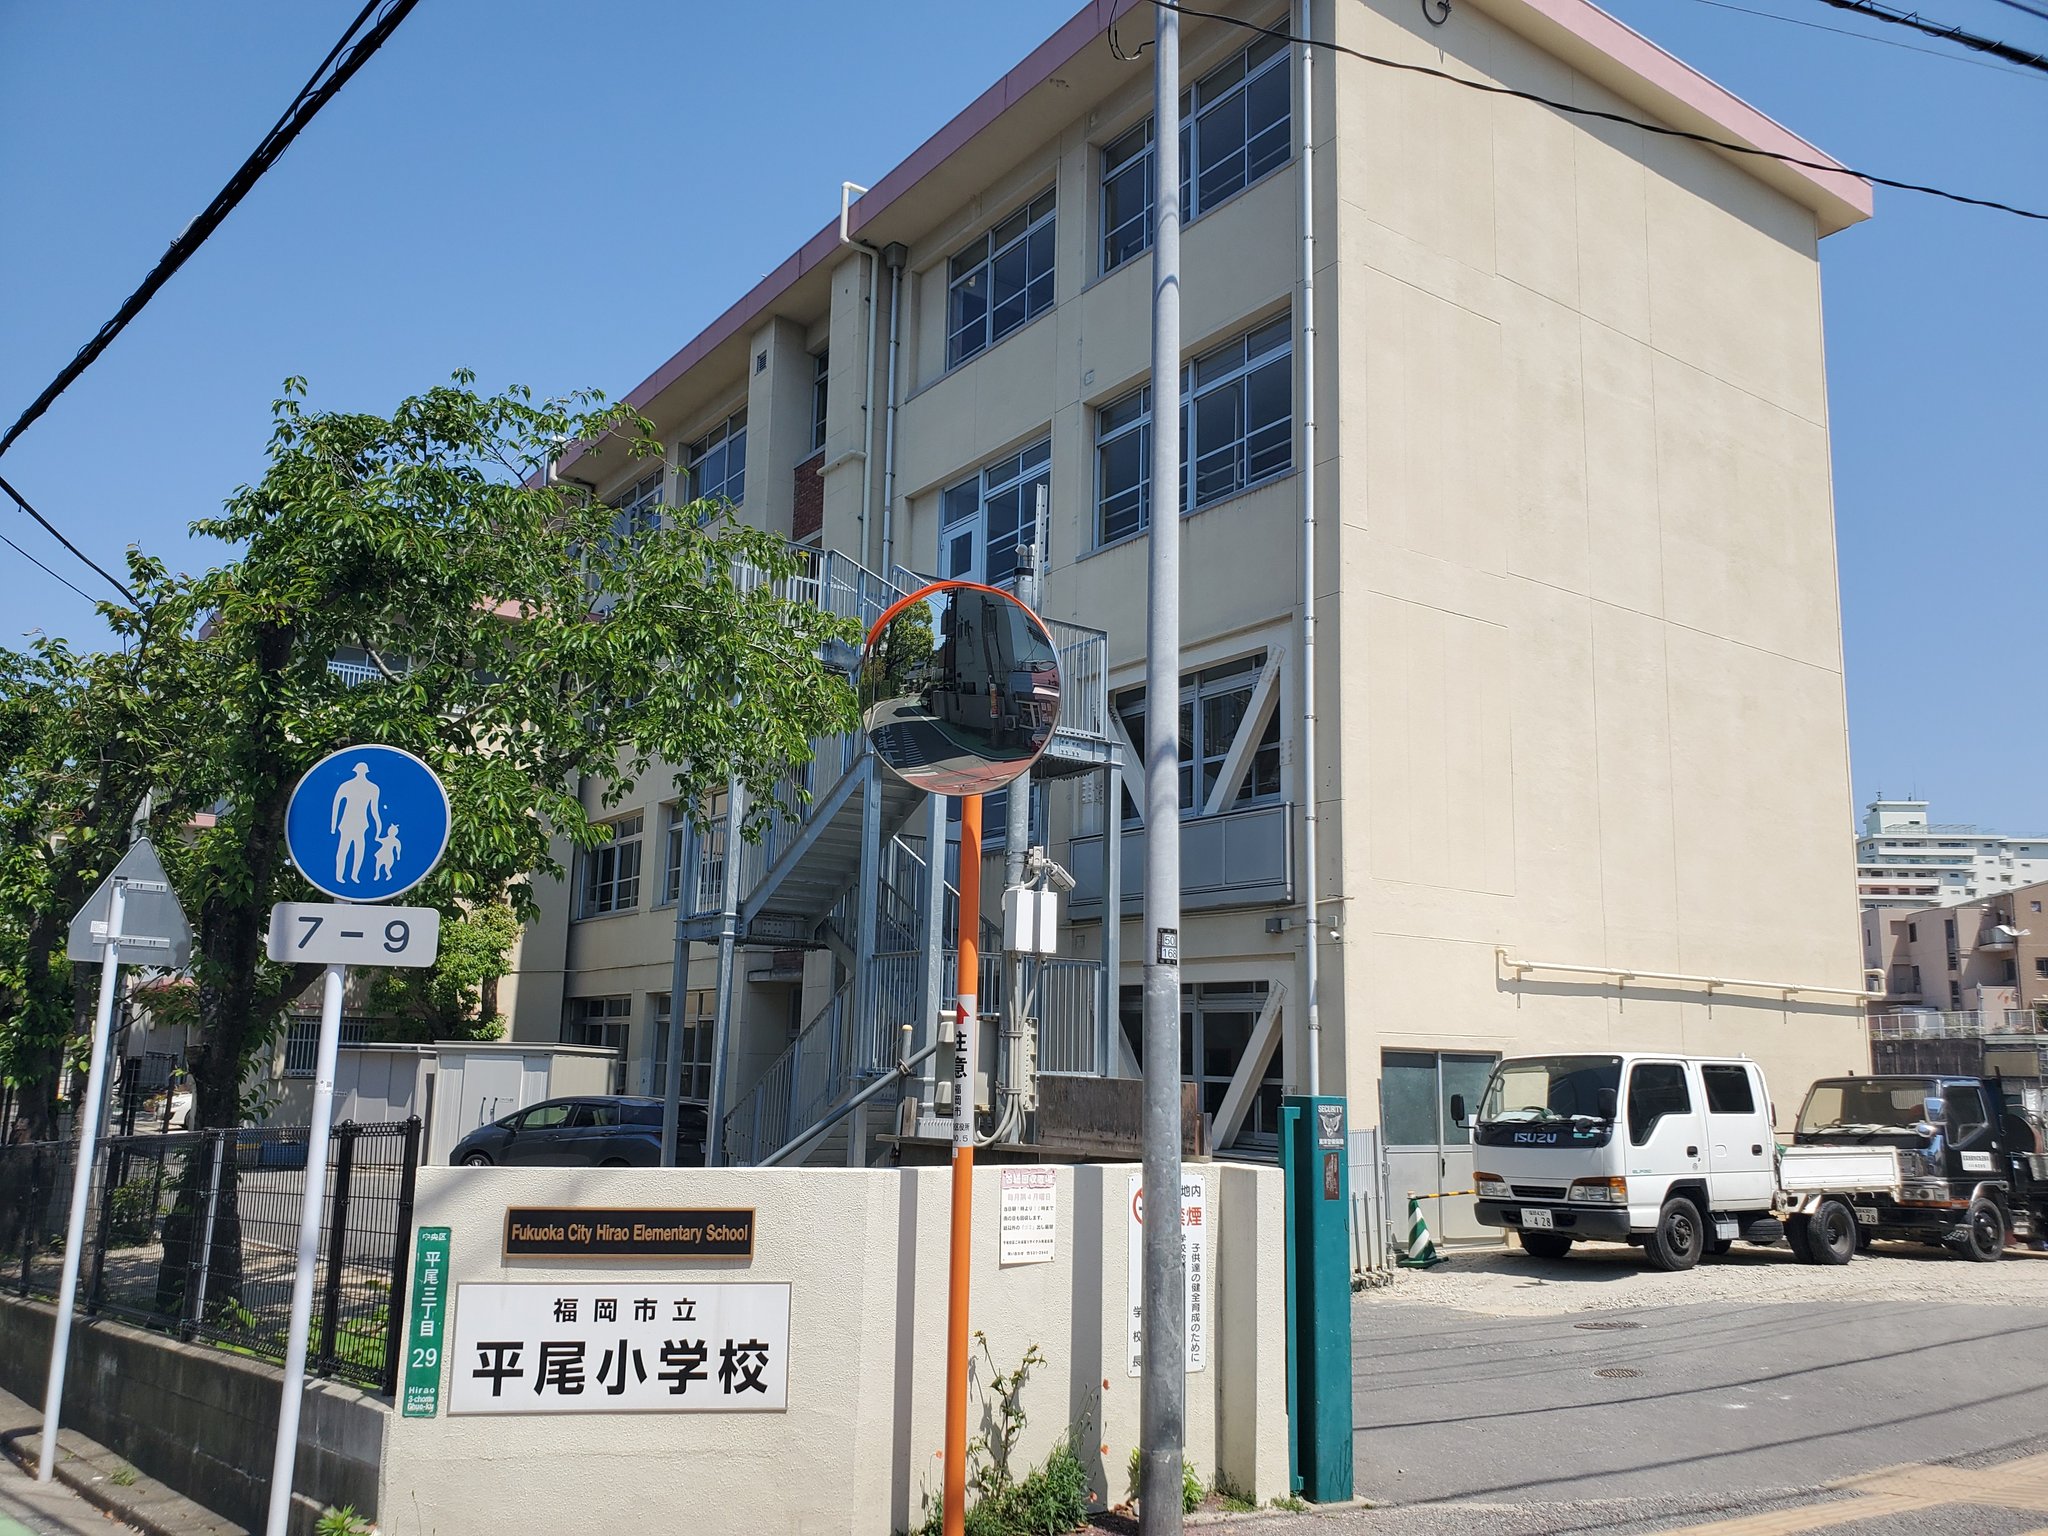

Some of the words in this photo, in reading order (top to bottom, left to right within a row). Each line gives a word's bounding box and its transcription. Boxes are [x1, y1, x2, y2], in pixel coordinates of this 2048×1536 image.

[1164, 935, 1175, 945] 50
[1317, 1105, 1343, 1114] SECURITY
[1514, 1132, 1557, 1143] ISUZU
[422, 1233, 447, 1241] 中央区
[511, 1223, 564, 1241] Fukuoka
[567, 1223, 593, 1244] City
[596, 1224, 630, 1241] Hirao
[633, 1224, 703, 1244] Elementary
[706, 1223, 748, 1241] School
[419, 1251, 441, 1337] 平尾三丁目
[1190, 1243, 1201, 1362] 子供達の健全育成のために
[553, 1298, 697, 1323] 福岡市立
[412, 1348, 437, 1368] 29
[472, 1338, 769, 1397] 平尾小学校
[408, 1386, 436, 1394] Hirao
